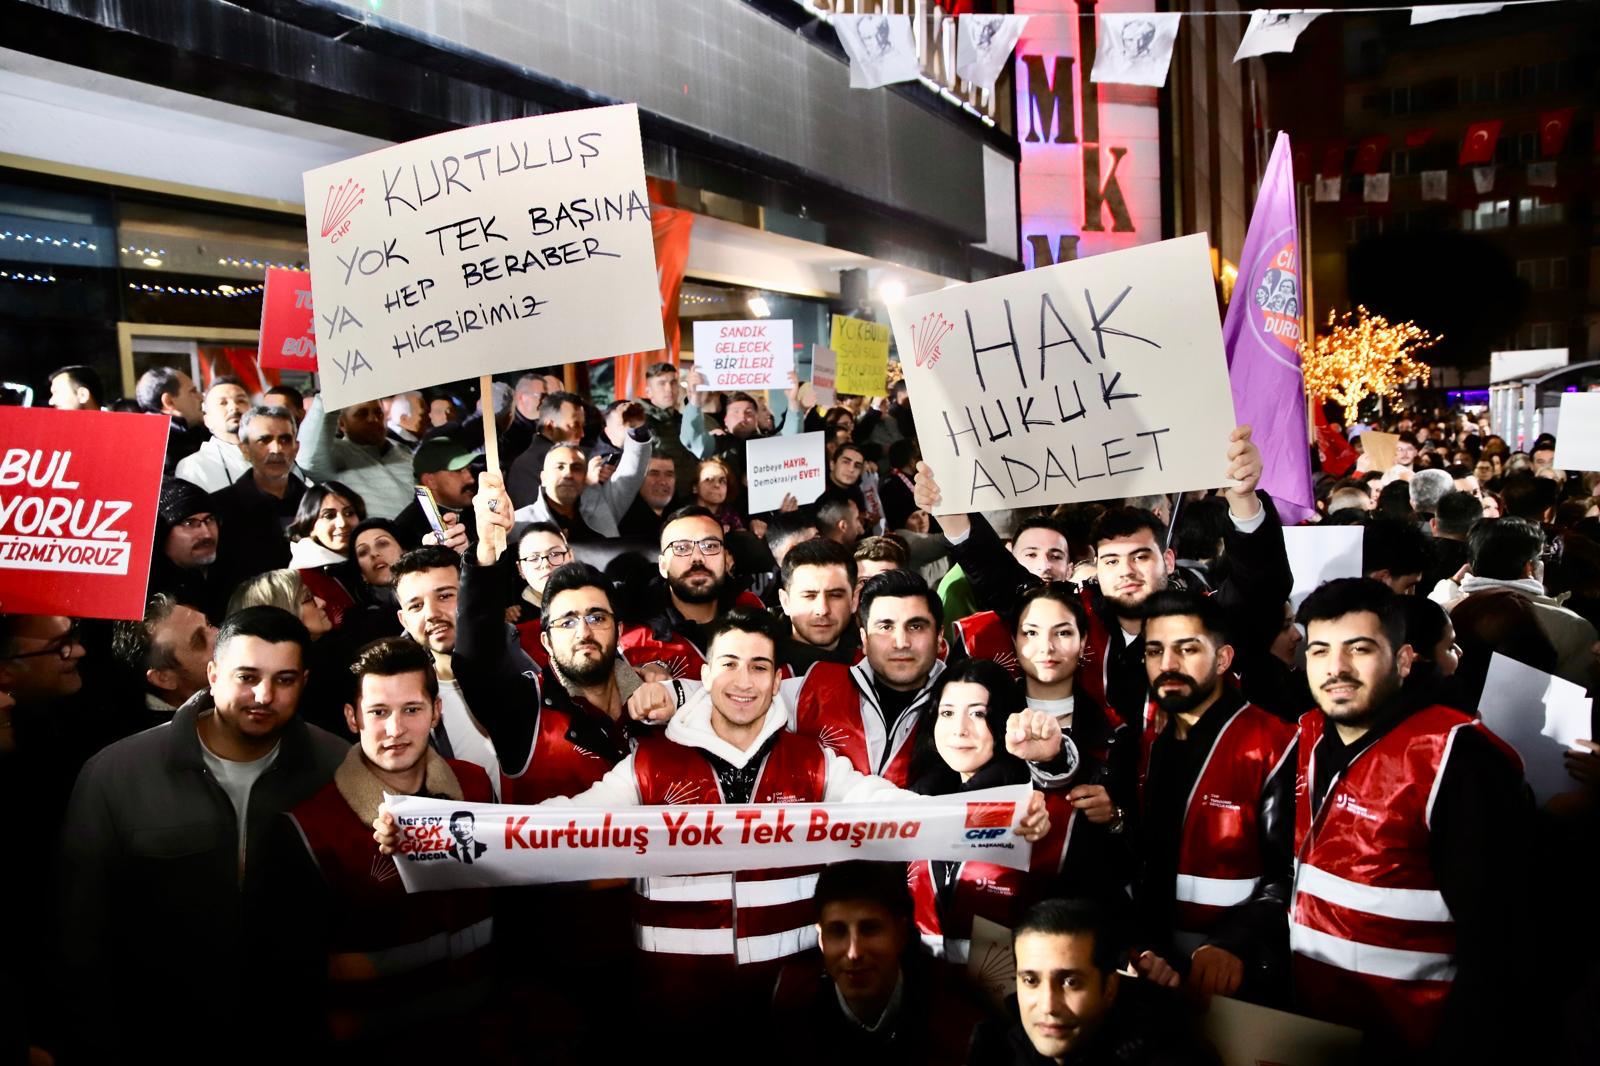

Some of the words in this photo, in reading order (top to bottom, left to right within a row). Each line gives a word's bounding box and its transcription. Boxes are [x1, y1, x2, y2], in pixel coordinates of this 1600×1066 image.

[384, 132, 602, 217] KURTULUŞ
[330, 220, 352, 244] CHP
[337, 238, 409, 286] YOK
[425, 215, 508, 256] TEK
[528, 190, 652, 236] BAŞINA
[322, 305, 363, 340] YA
[384, 278, 435, 314] HEP
[461, 238, 621, 288] BERABER
[720, 325, 767, 338] SANDIK
[965, 286, 1162, 392] HAK
[715, 341, 772, 354] GELECEK
[927, 345, 941, 370] CHP
[332, 349, 373, 385] YA
[717, 371, 772, 385] GİDECEK
[942, 372, 1142, 457] HUKUK
[753, 463, 782, 474] Darbeye
[783, 456, 808, 469] HAYIR,
[799, 468, 820, 480] EVET!
[971, 428, 1170, 505] ADALET
[398, 816, 419, 825] her
[505, 812, 649, 854] Kurtuluş
[662, 810, 724, 846] Yok
[735, 809, 795, 844] Tek
[806, 809, 921, 848] Başına
[965, 829, 1007, 840] CHP
